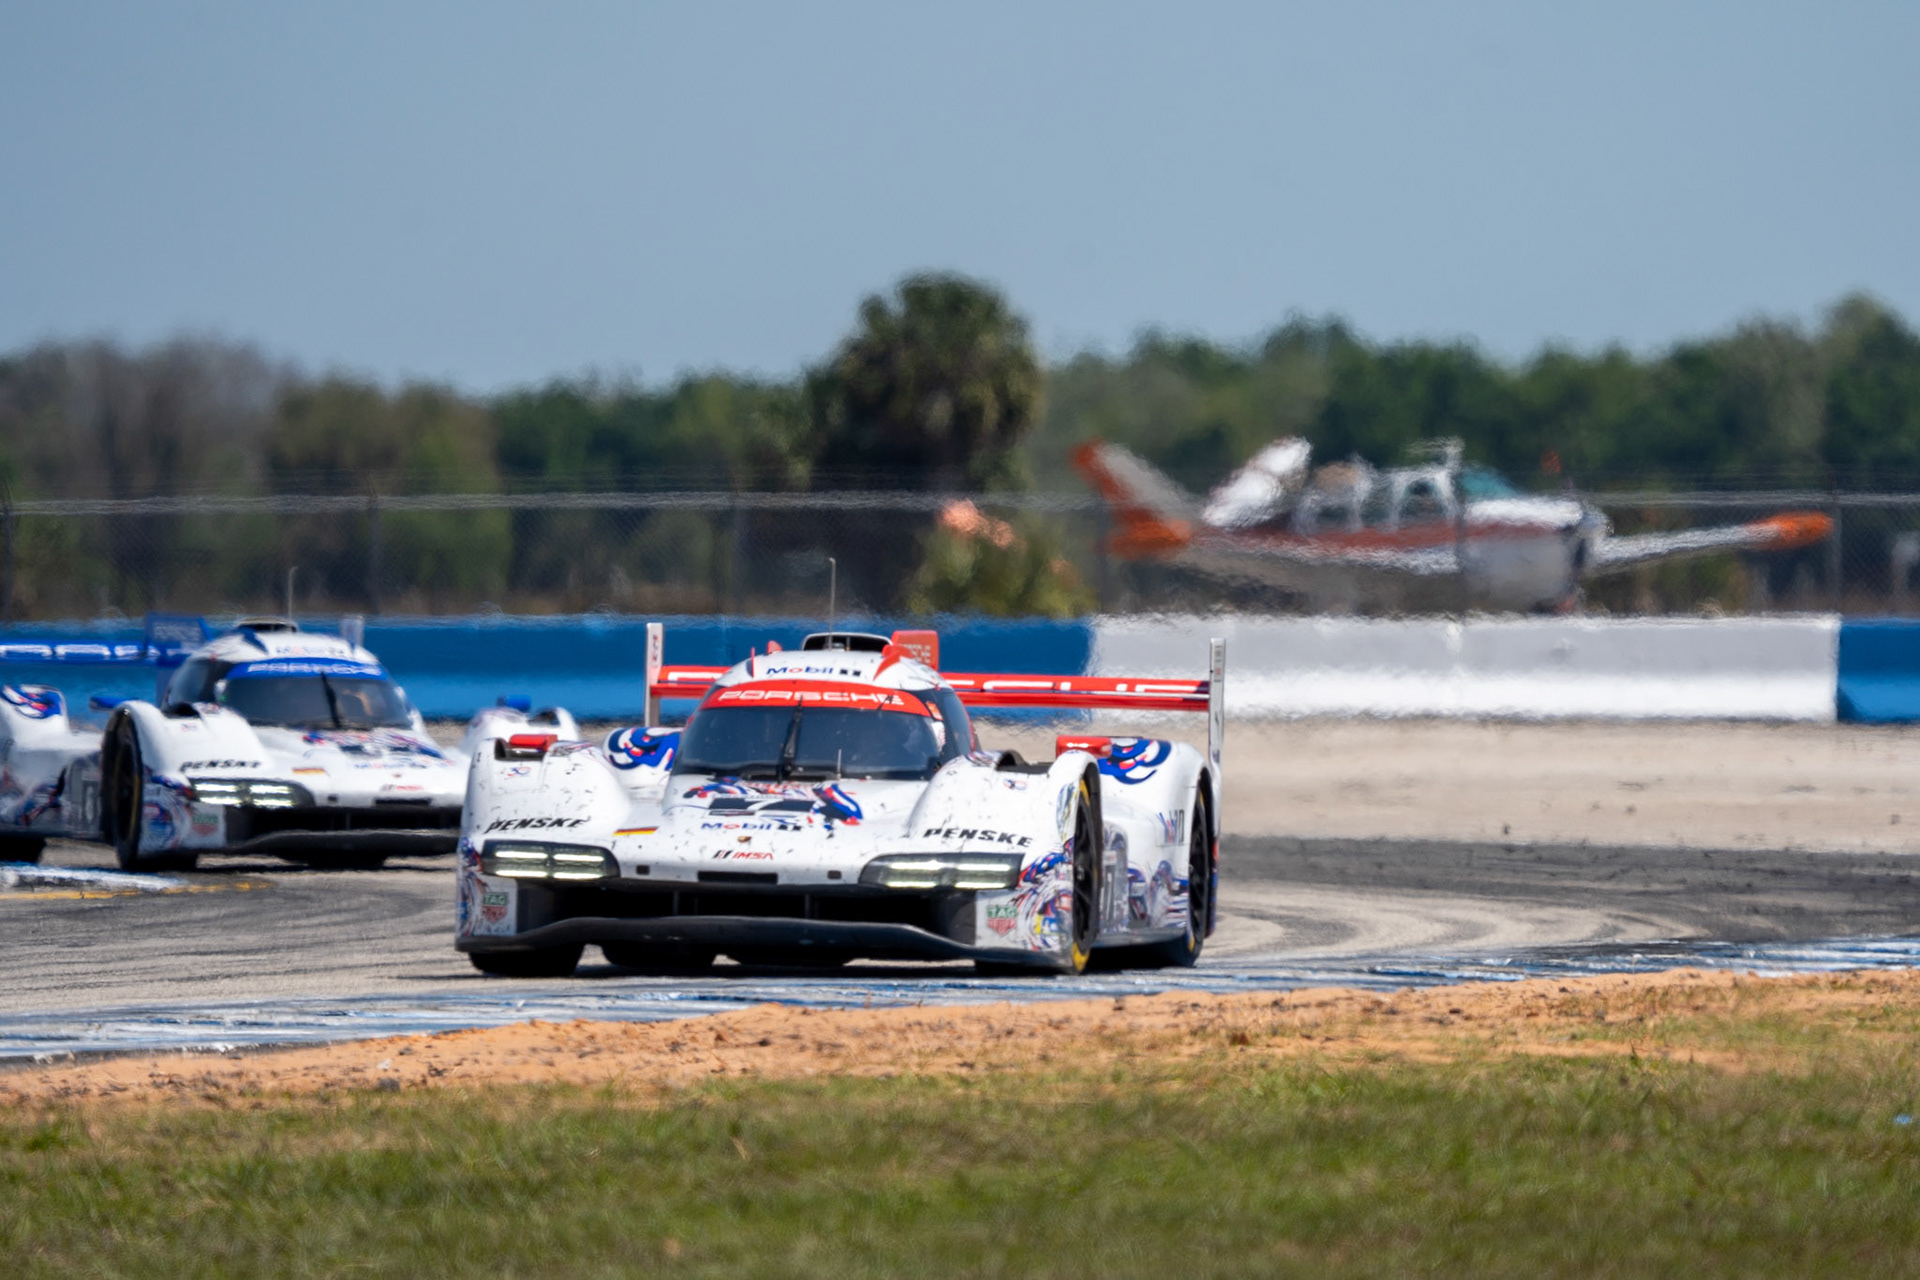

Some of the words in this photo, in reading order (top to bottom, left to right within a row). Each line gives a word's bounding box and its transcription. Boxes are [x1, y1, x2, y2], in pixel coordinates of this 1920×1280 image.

[766, 665, 833, 675] Mobil
[718, 689, 905, 706] PORSCHE
[484, 817, 587, 835] PENSKE
[701, 822, 772, 831] Mobil
[923, 827, 1034, 848] PENSKE
[484, 893, 507, 906] TAG
[988, 907, 1017, 918] TAG
